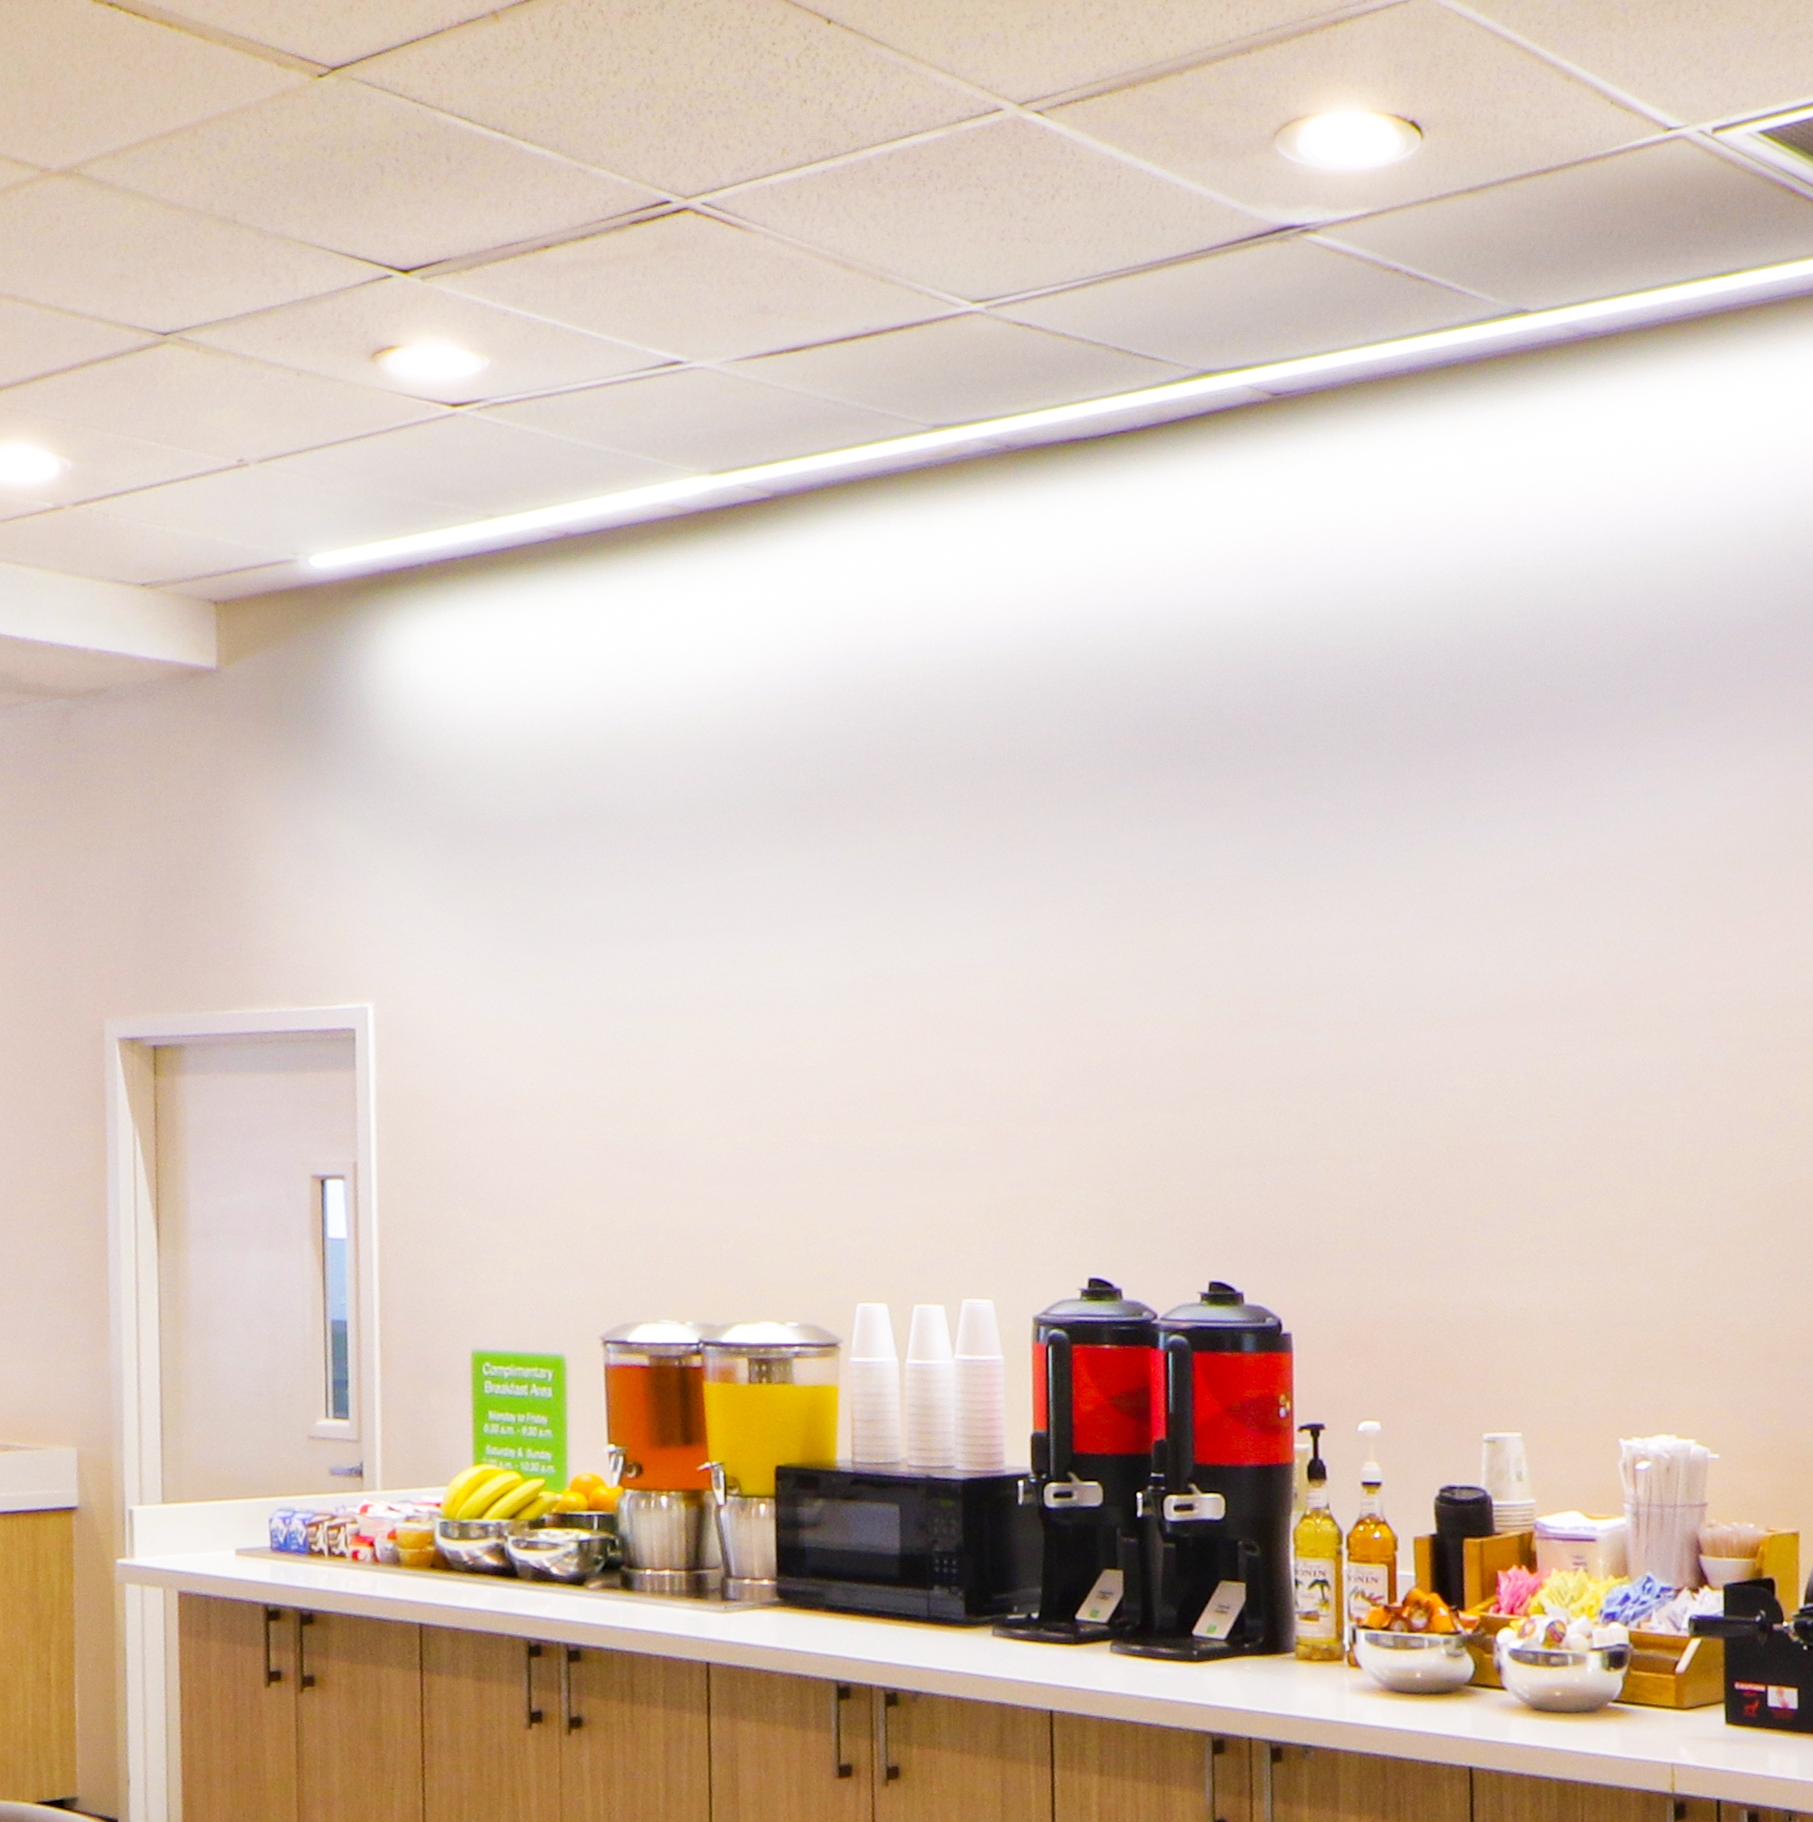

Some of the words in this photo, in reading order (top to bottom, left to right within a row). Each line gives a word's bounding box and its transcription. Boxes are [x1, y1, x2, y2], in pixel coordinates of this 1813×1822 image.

[482, 1361, 554, 1382] Complimentary
[484, 1380, 528, 1396] Breakfast
[530, 1383, 553, 1398] Area
